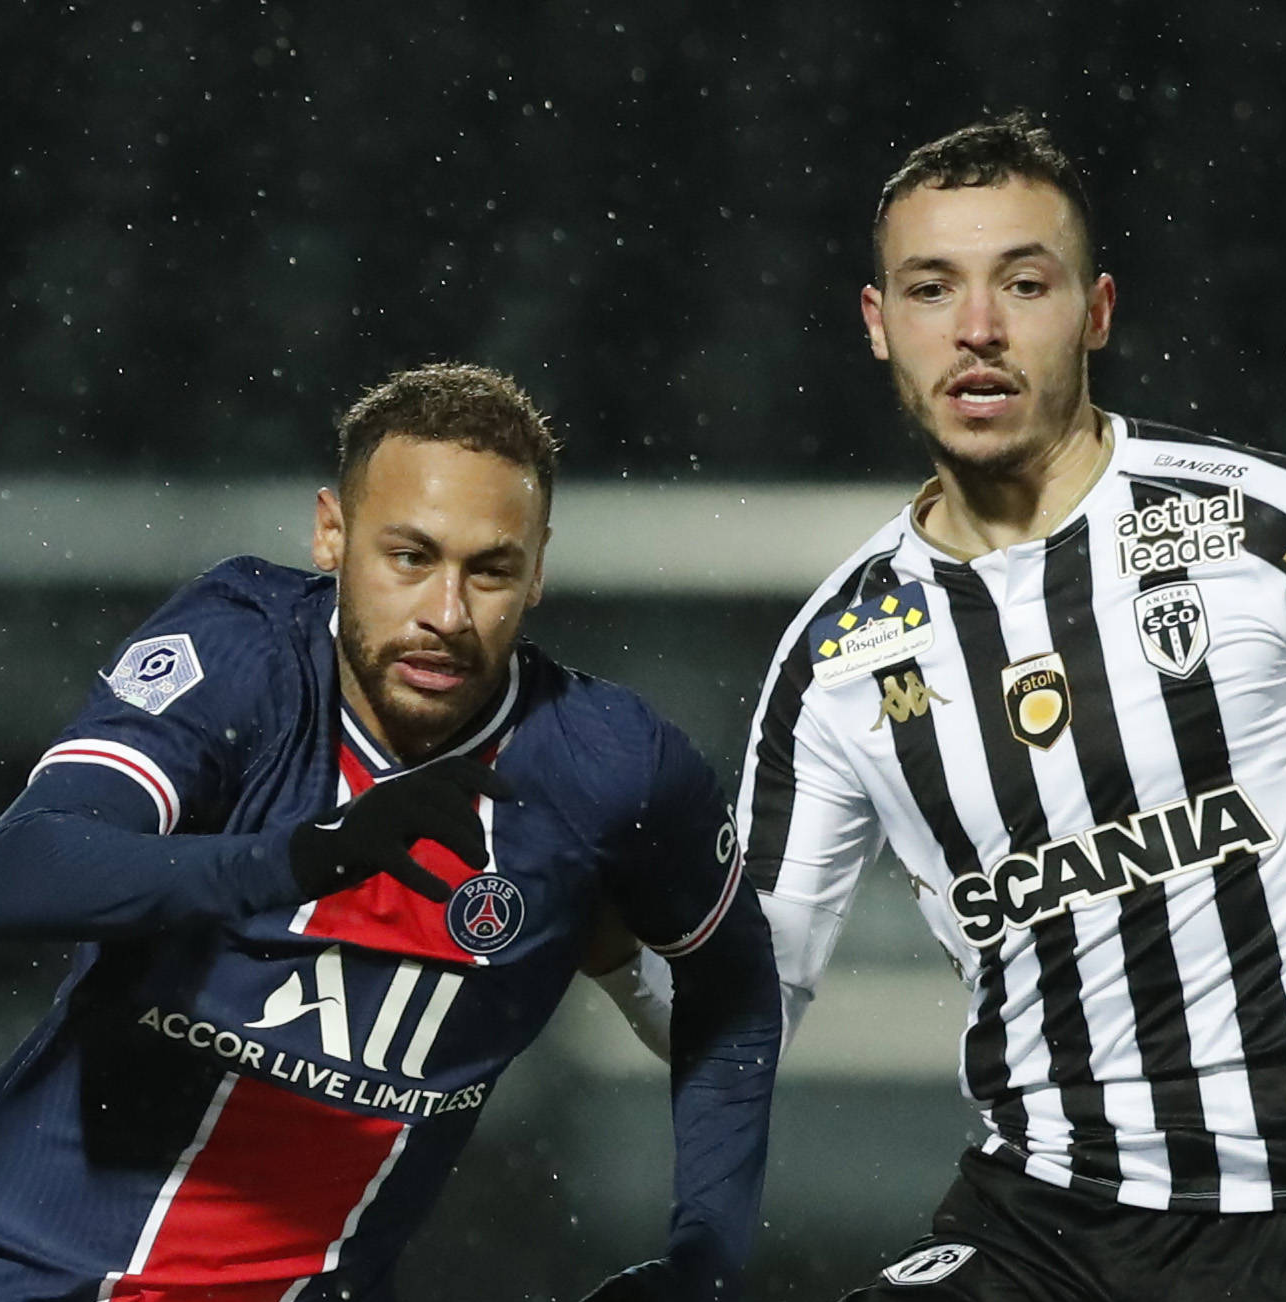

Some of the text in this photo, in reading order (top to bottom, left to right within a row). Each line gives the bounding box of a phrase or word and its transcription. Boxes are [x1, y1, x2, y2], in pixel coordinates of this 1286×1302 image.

[1170, 459, 1249, 478] ANGERS
[1117, 487, 1241, 537] actual
[1119, 529, 1241, 574] leader
[1146, 588, 1190, 606] ANGERS
[1146, 607, 1195, 633] SCO
[845, 628, 900, 654] Pasquier
[950, 788, 1276, 943] SCANIA
[463, 879, 515, 900] PARIS
[138, 1006, 486, 1118] ACCOR LIVE LIMITLESS
